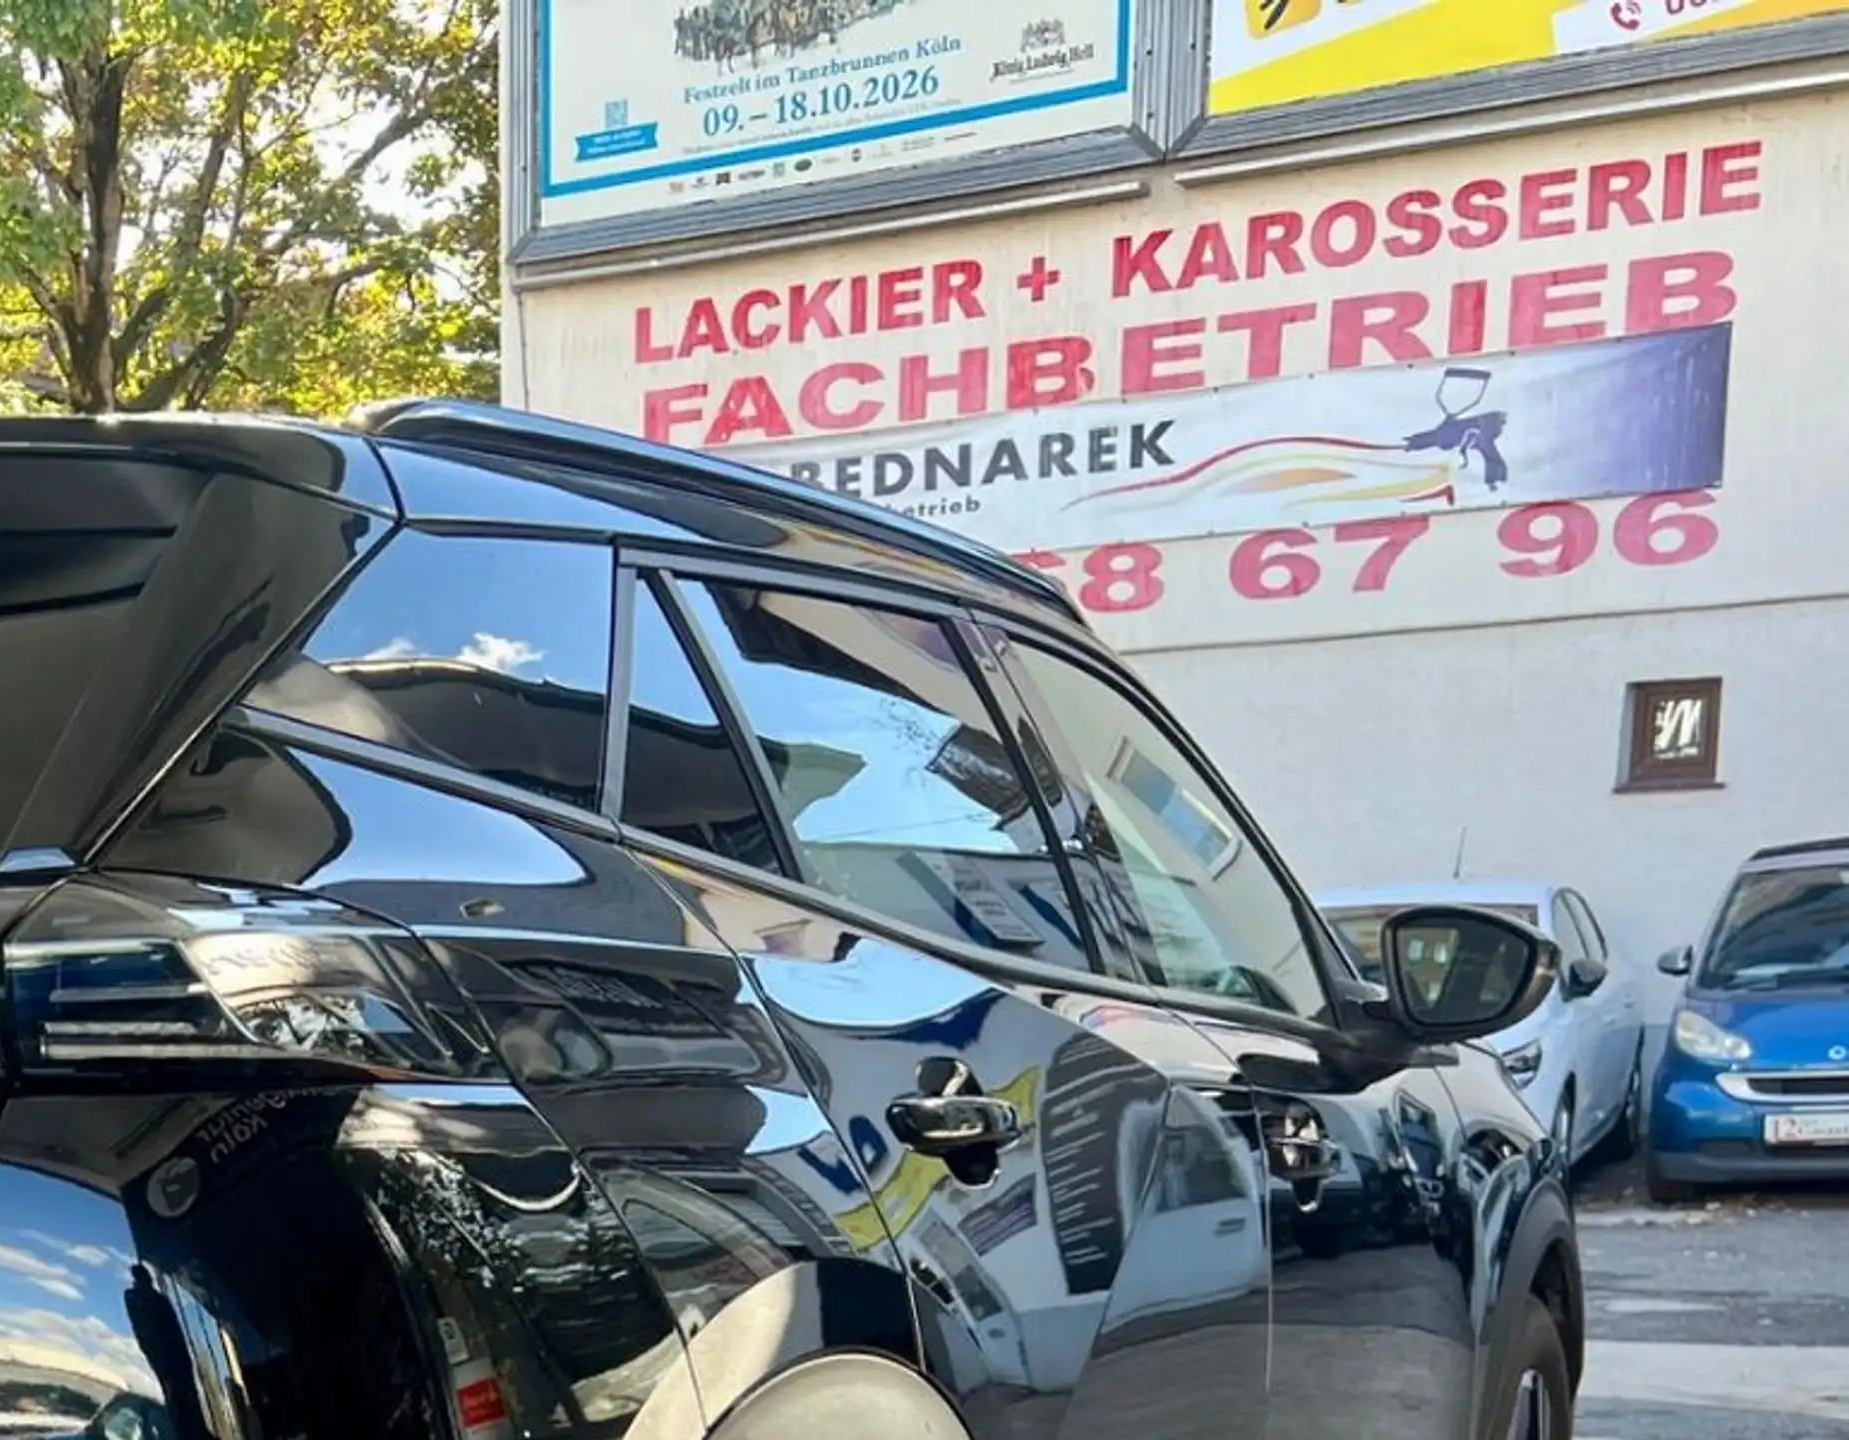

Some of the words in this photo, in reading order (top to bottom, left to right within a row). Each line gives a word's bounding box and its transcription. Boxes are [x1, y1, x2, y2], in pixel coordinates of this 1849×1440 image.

[683, 77, 751, 104] Festzelt
[755, 70, 781, 92] im
[786, 48, 910, 85] Tanzbrunnen
[915, 36, 961, 60] Köln
[774, 64, 940, 124] 18.10.2026
[634, 259, 984, 364] LACKIER
[1015, 256, 1061, 303] +
[1110, 141, 1763, 298] KAROSSERIE
[641, 251, 1738, 446] FACHBETRIEB
[789, 420, 1177, 499] BEDNAREK
[1228, 514, 1431, 600] 67
[1497, 489, 1720, 579] 96
